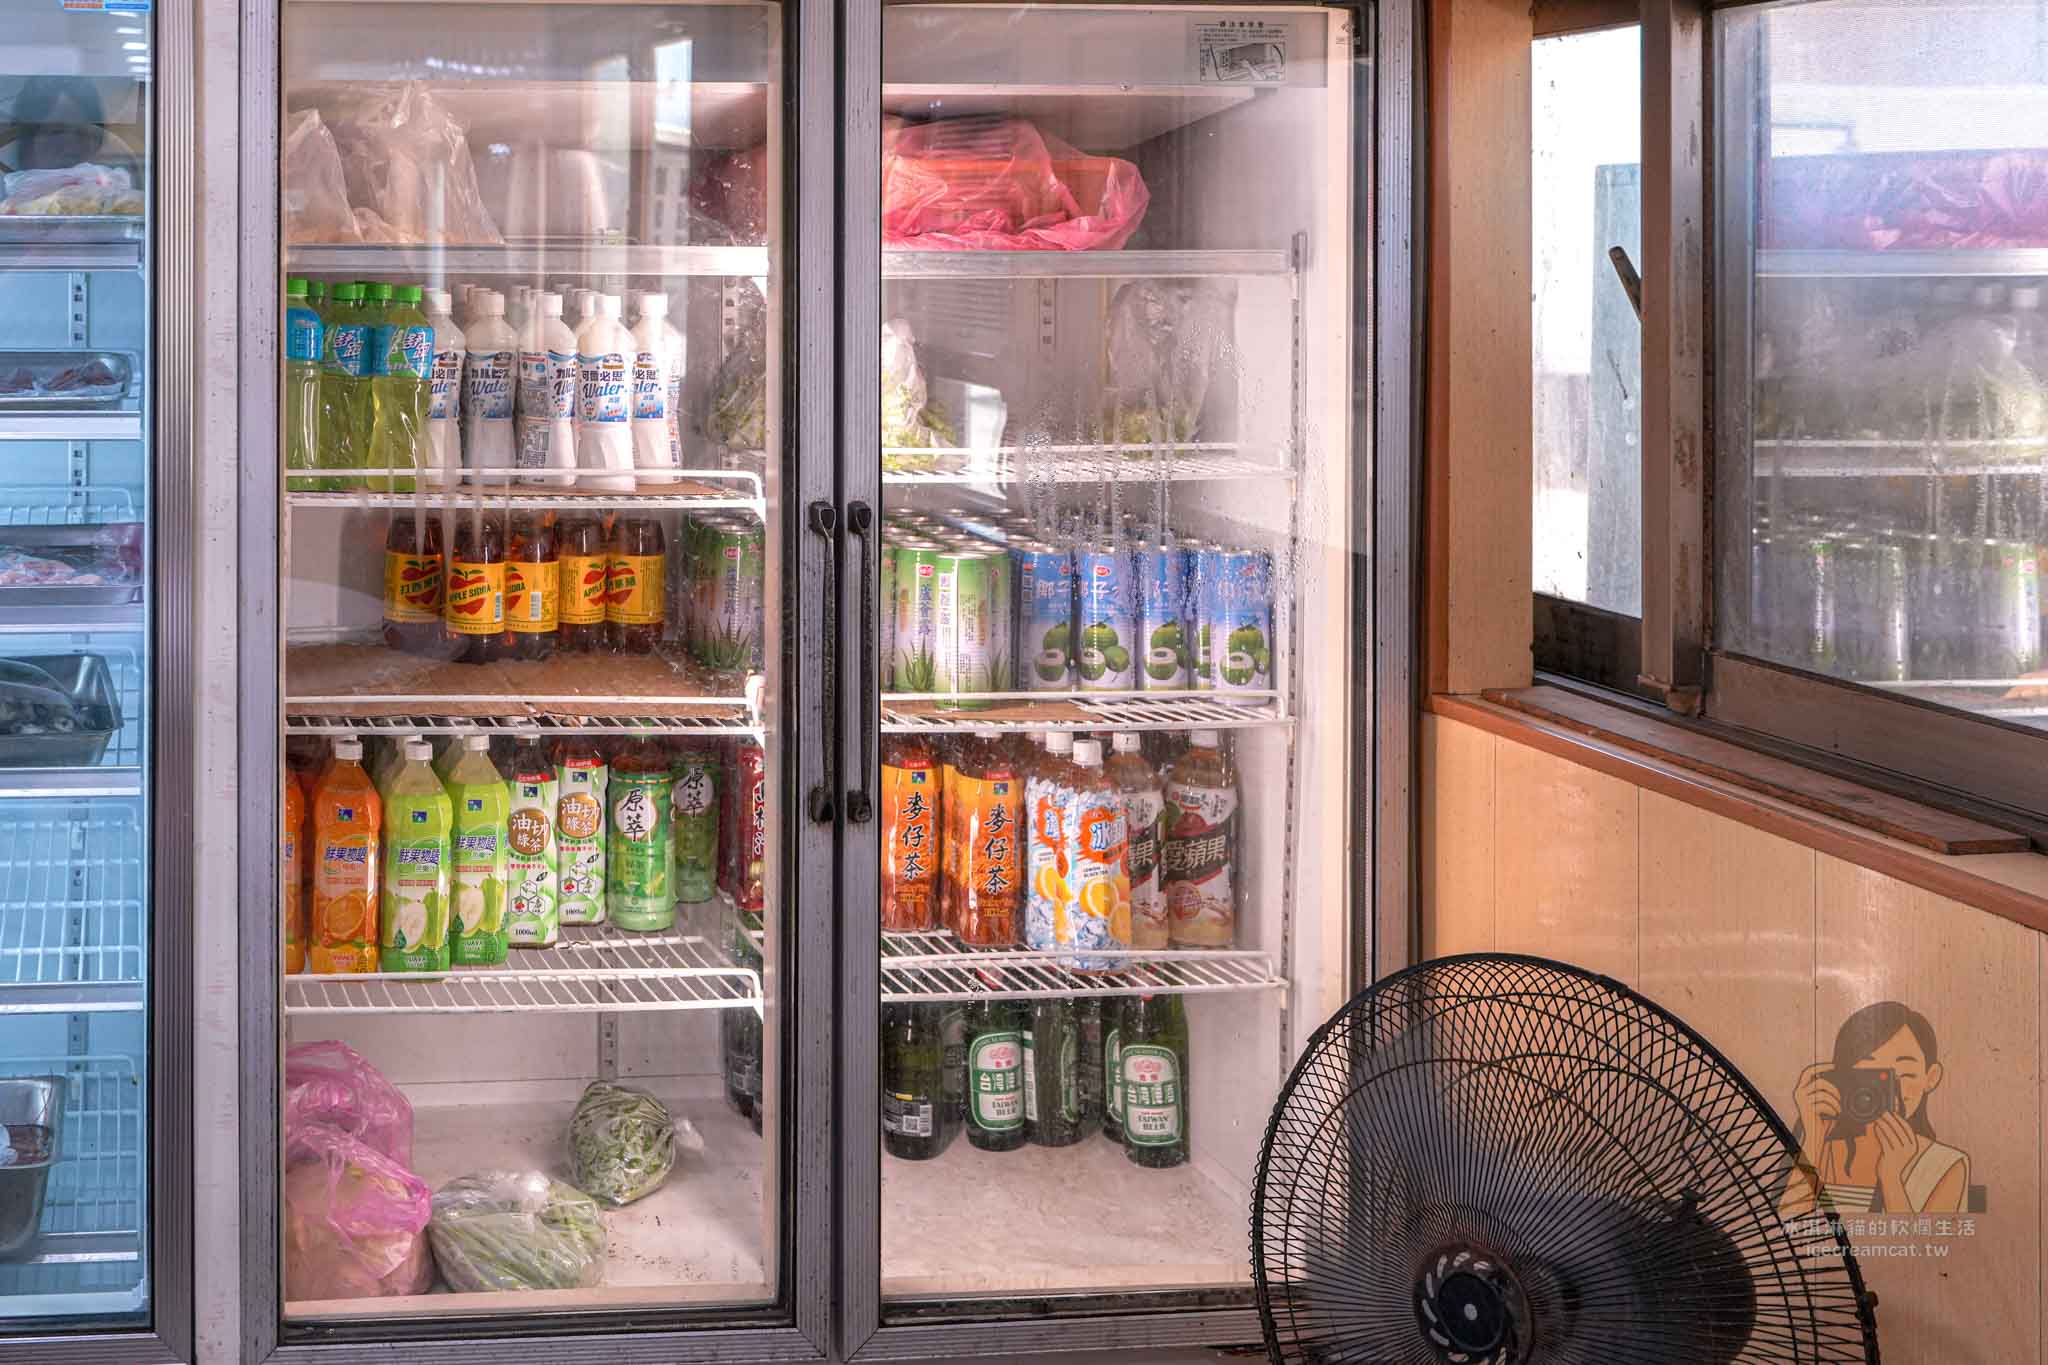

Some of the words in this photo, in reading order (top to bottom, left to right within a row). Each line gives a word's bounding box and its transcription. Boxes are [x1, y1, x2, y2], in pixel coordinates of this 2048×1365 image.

[582, 381, 625, 399] Water
[512, 812, 549, 838] 油切
[620, 788, 645, 842] 原萃
[902, 791, 929, 880] 麥仔茶
[984, 803, 1013, 895] 麥仔茶
